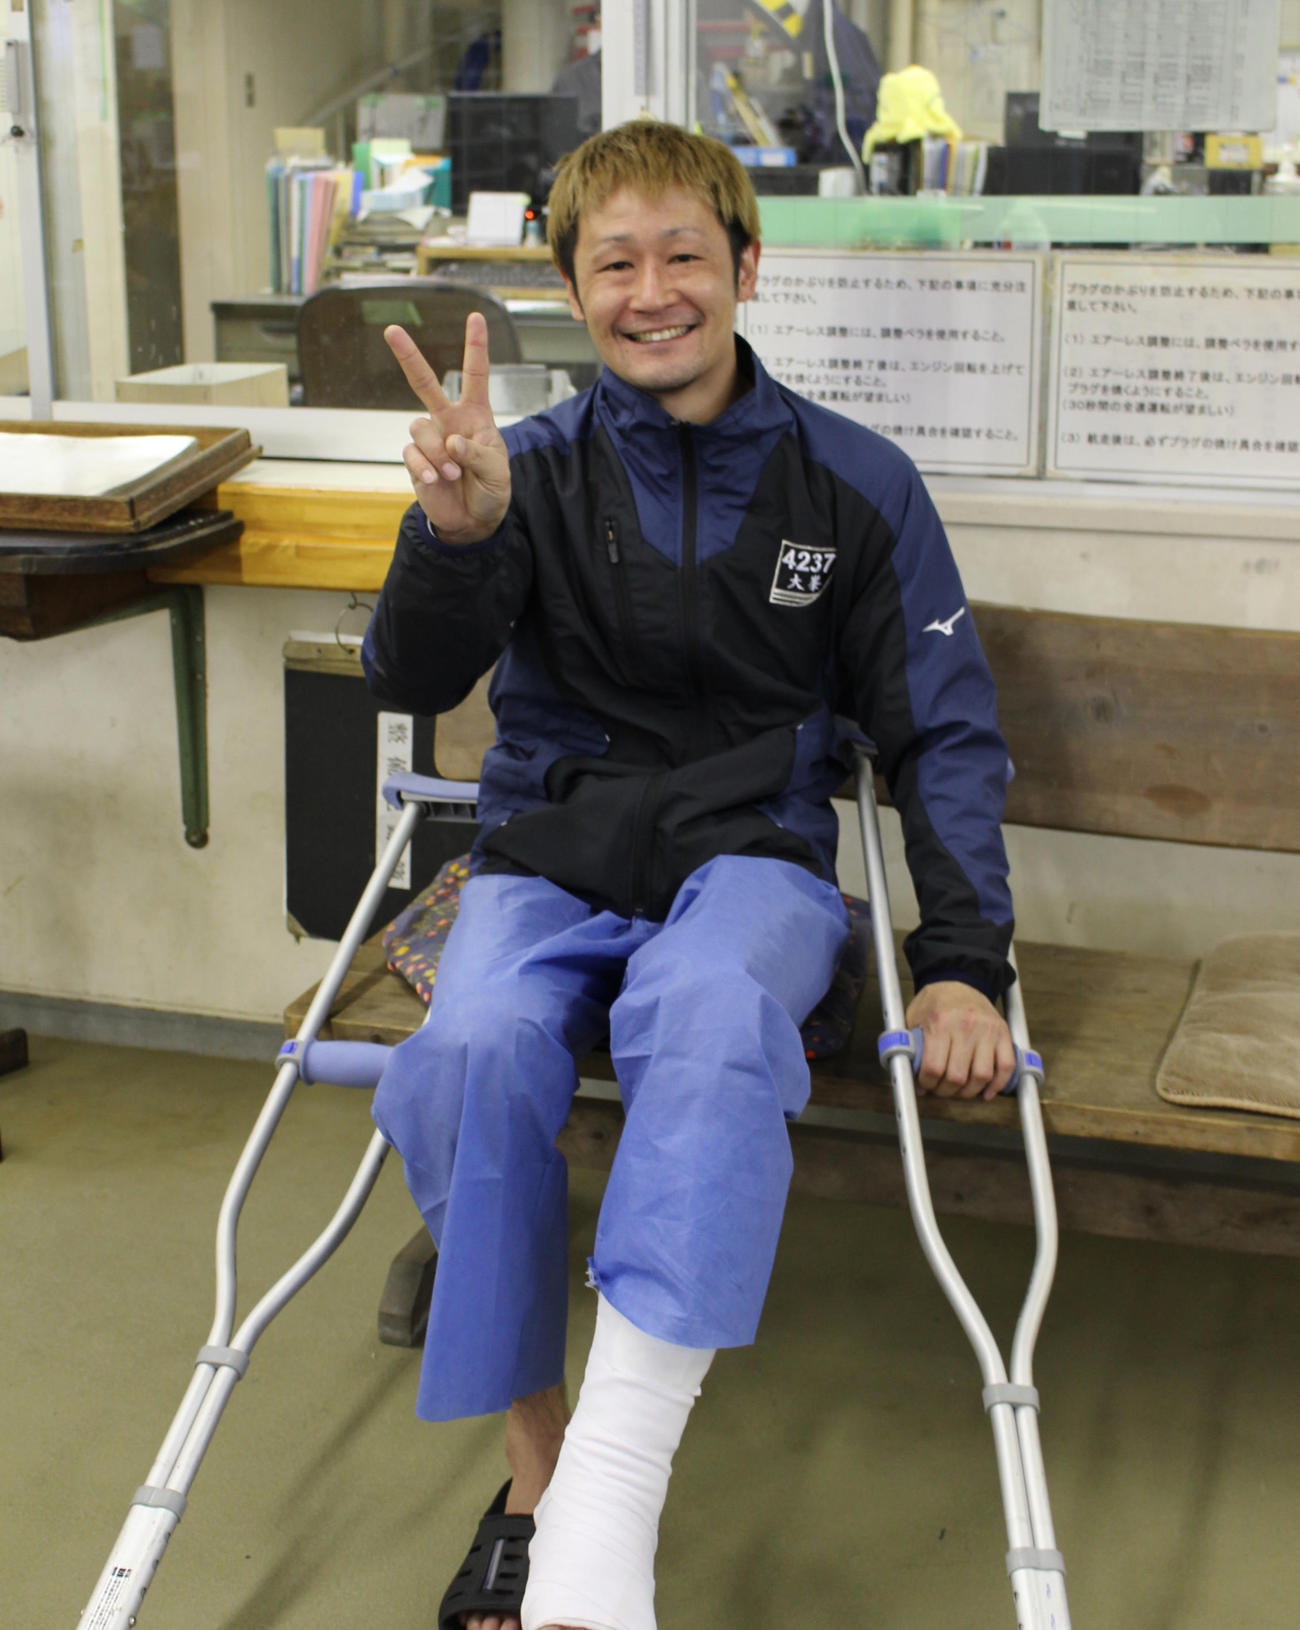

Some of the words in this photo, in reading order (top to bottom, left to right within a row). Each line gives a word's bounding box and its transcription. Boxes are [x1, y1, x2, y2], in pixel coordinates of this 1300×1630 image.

[757, 275, 1026, 293] ラグのかぶりを防止するため、下記の事項に充分注
[1067, 282, 1300, 300] プラグのかぶりを防止するため、下記の事
[782, 549, 836, 573] 4237
